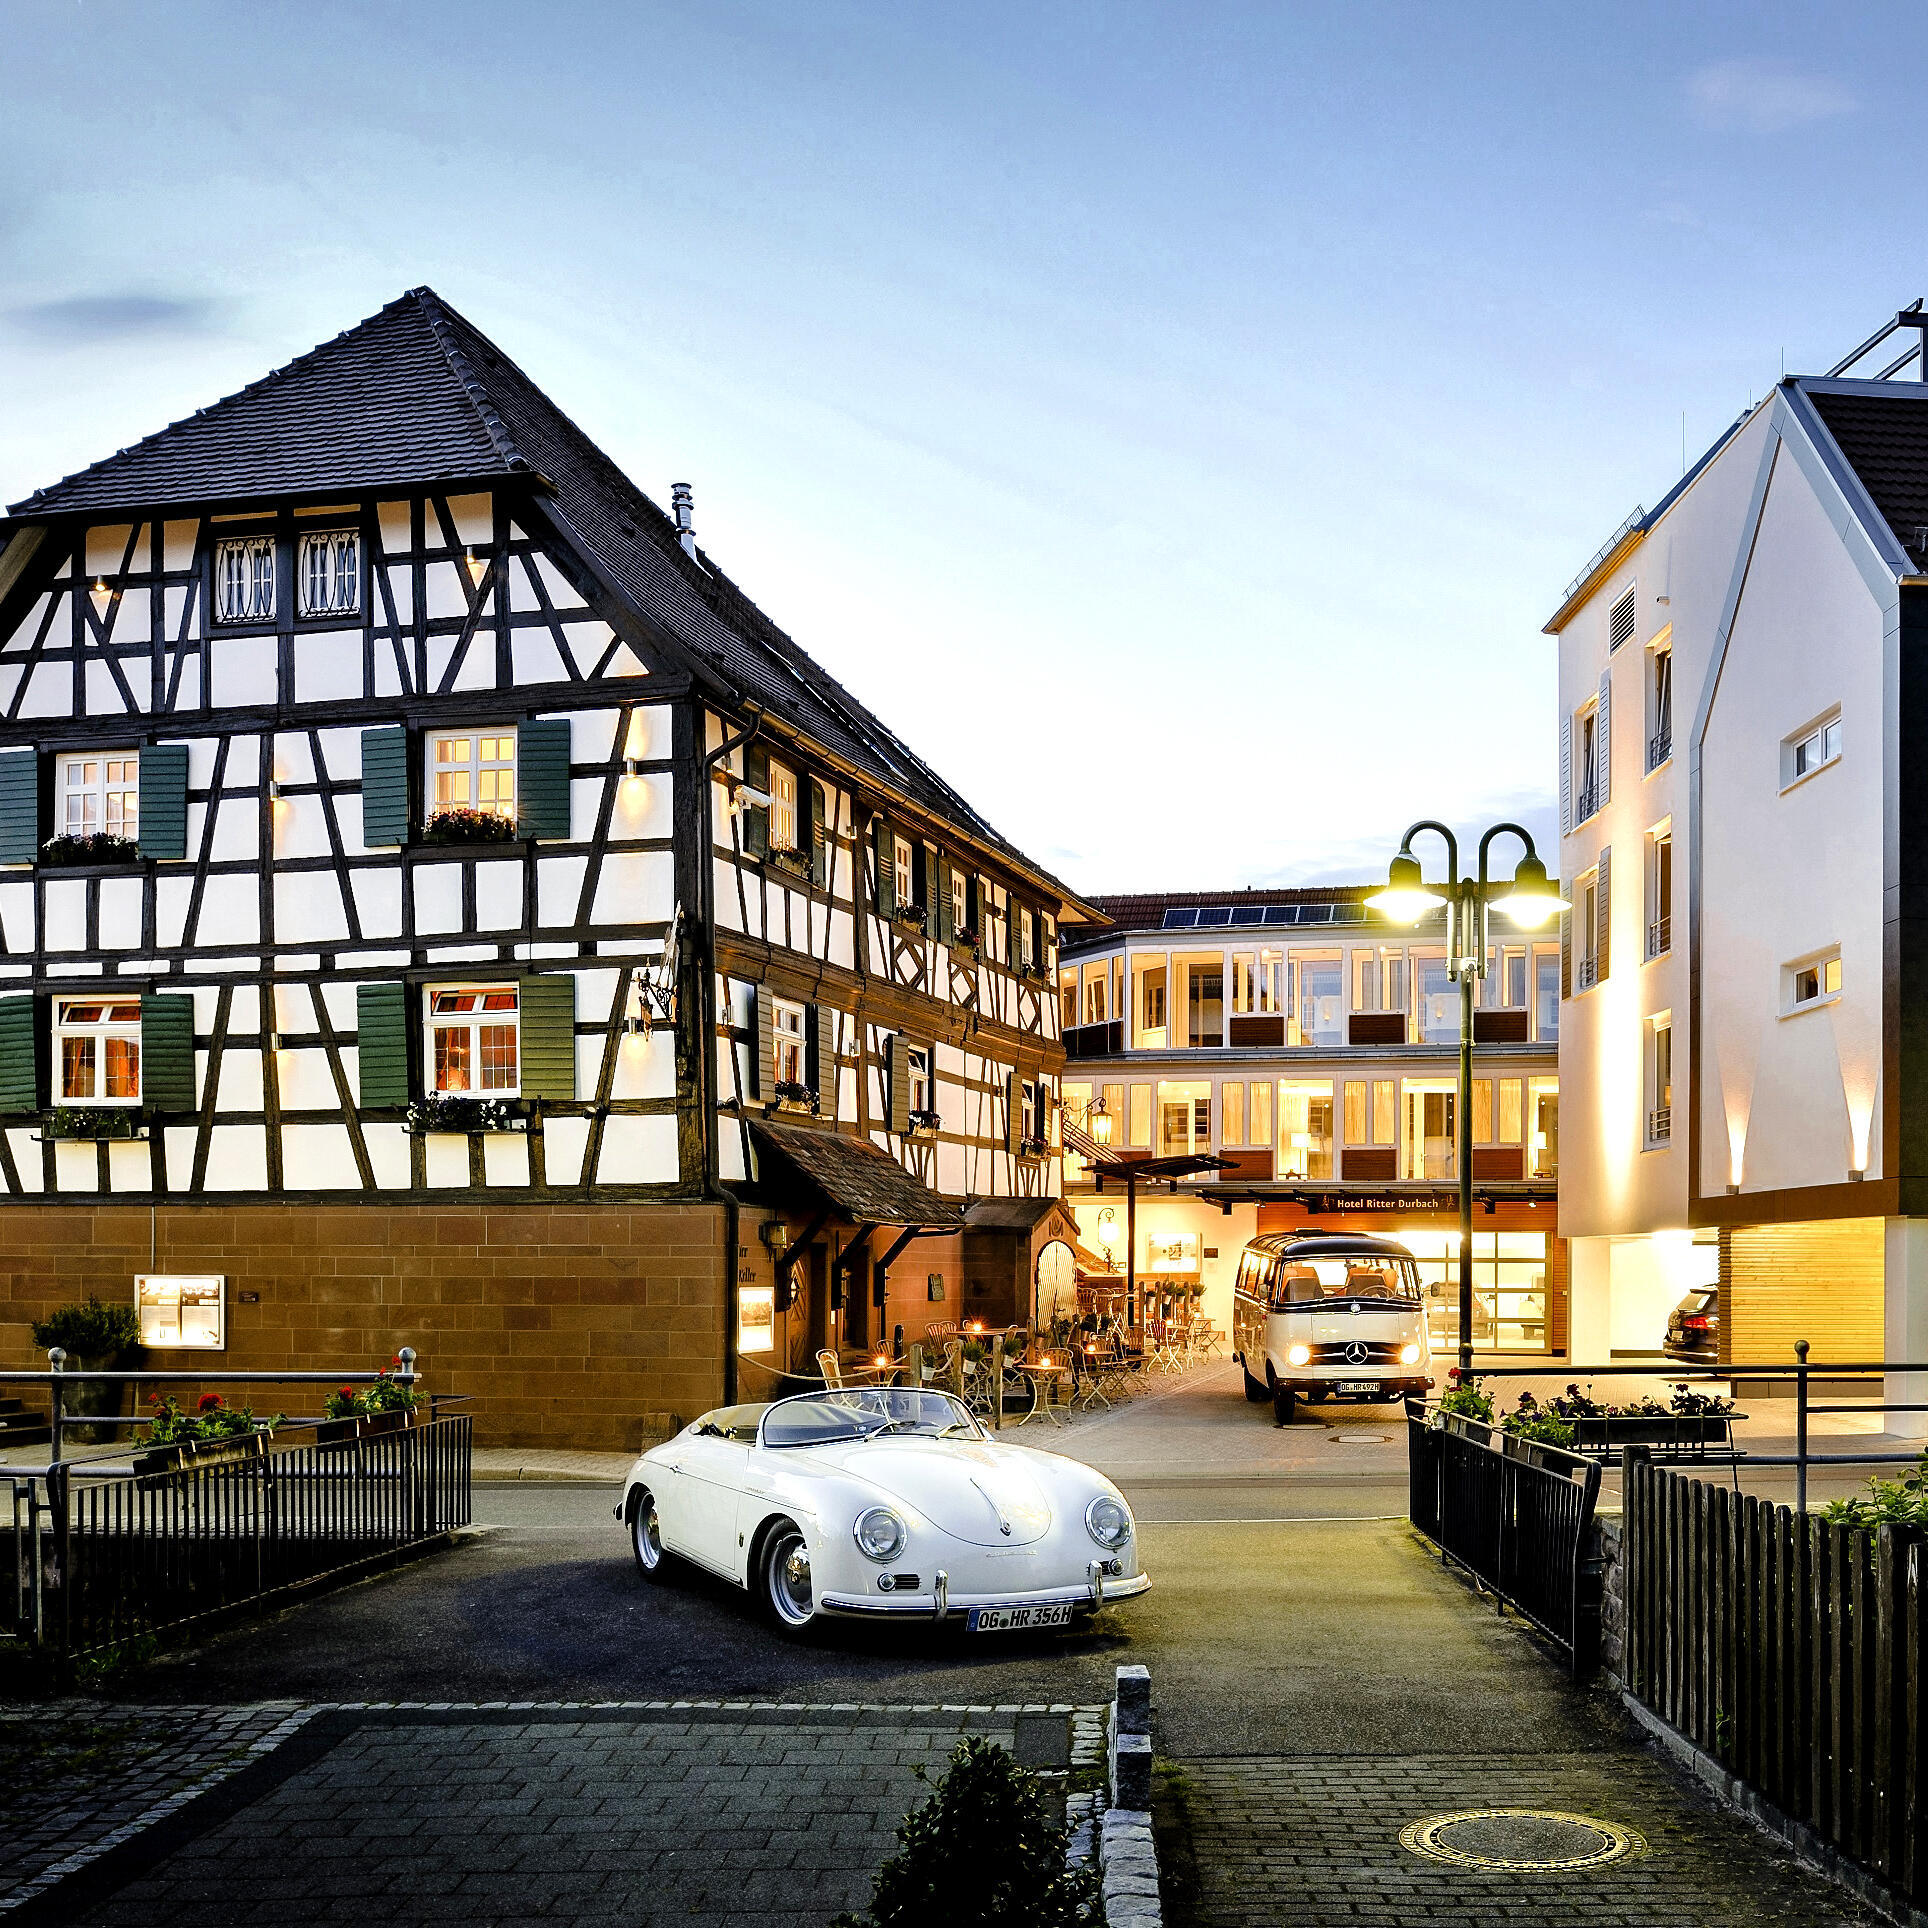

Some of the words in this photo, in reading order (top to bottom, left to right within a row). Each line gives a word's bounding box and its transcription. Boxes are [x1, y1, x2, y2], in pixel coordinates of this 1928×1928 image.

[1337, 1199, 1364, 1208] Hotel
[1366, 1199, 1395, 1208] Ritter
[1398, 1199, 1439, 1208] Durbach
[1341, 1383, 1350, 1391] OG
[978, 1611, 1000, 1629] OG
[1009, 1609, 1031, 1627] HR
[1032, 1605, 1073, 1625] 356H
